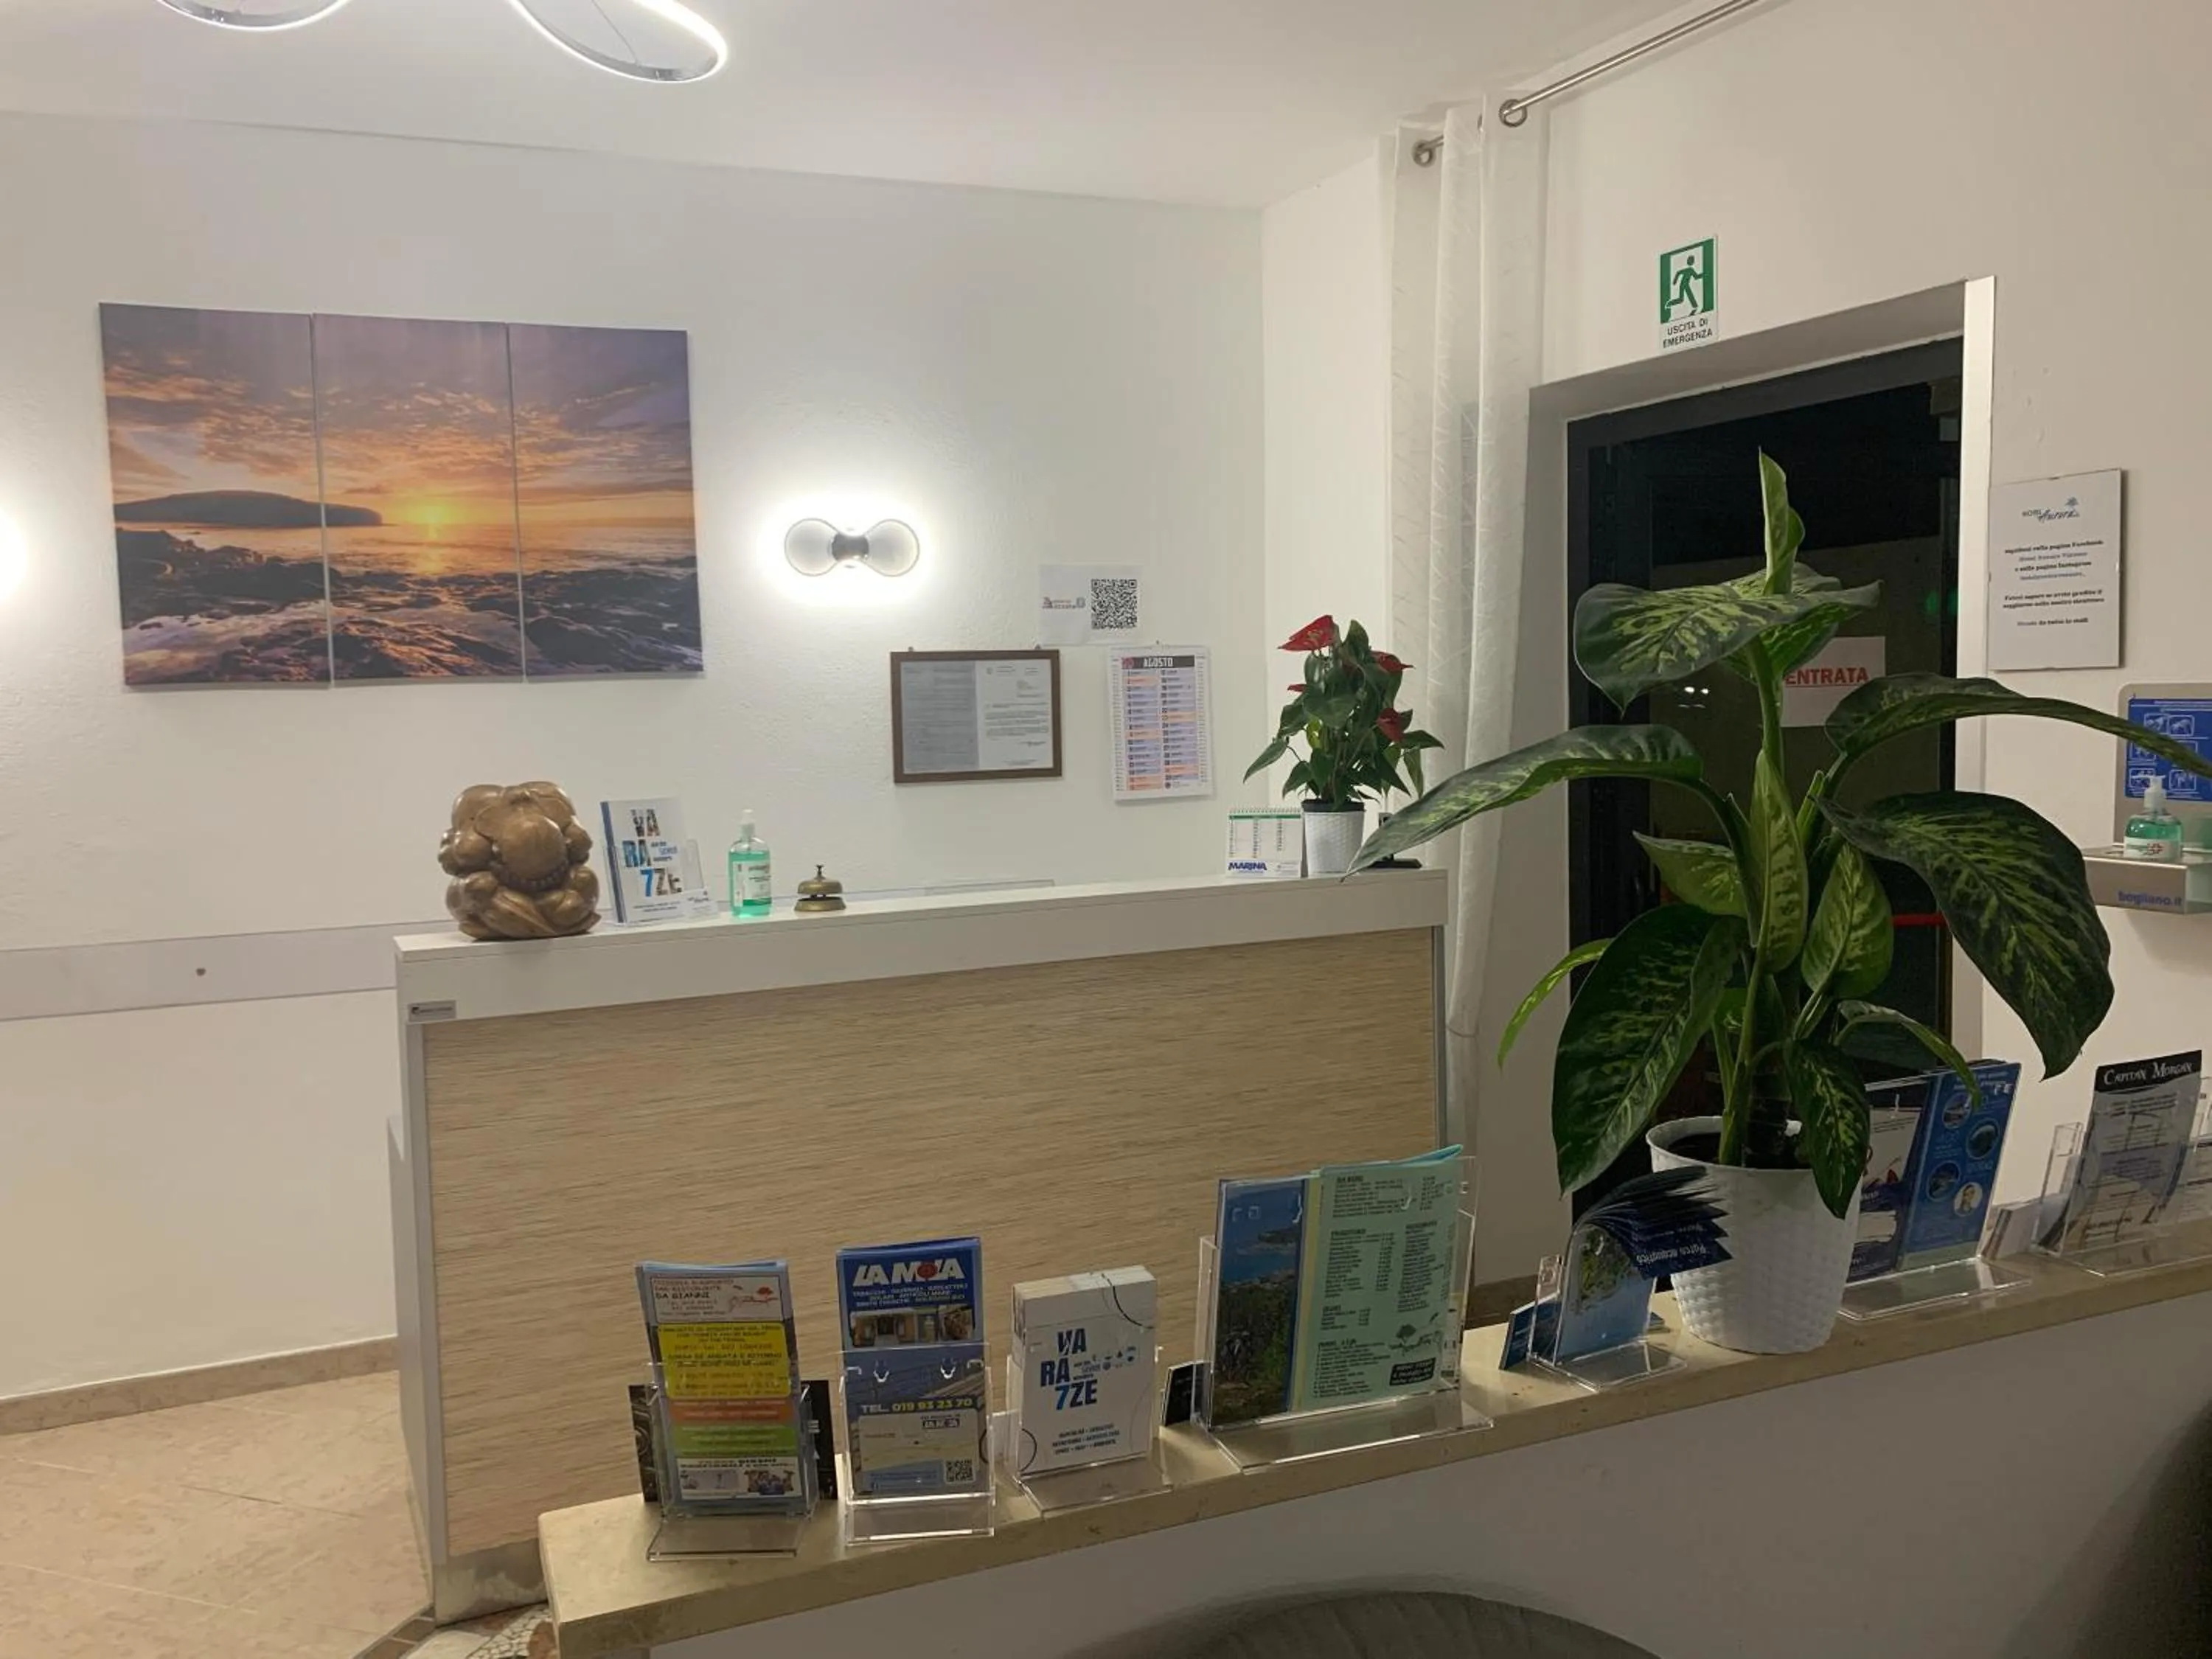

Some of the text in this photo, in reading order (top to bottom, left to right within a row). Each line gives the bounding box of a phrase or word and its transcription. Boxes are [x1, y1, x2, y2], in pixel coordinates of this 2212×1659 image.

[1667, 318, 1708, 335] USCITA DI
[1663, 328, 1713, 348] EMERGENZA
[1143, 657, 1173, 668] AGOSTO
[1784, 667, 1869, 685] ENTRATA
[1228, 862, 1267, 871] MARINA
[852, 1264, 890, 1287] LA
[1057, 1327, 1087, 1356] VA
[1040, 1357, 1070, 1386] RA
[1054, 1379, 1098, 1411] 7ZE
[891, 1402, 915, 1412] 019
